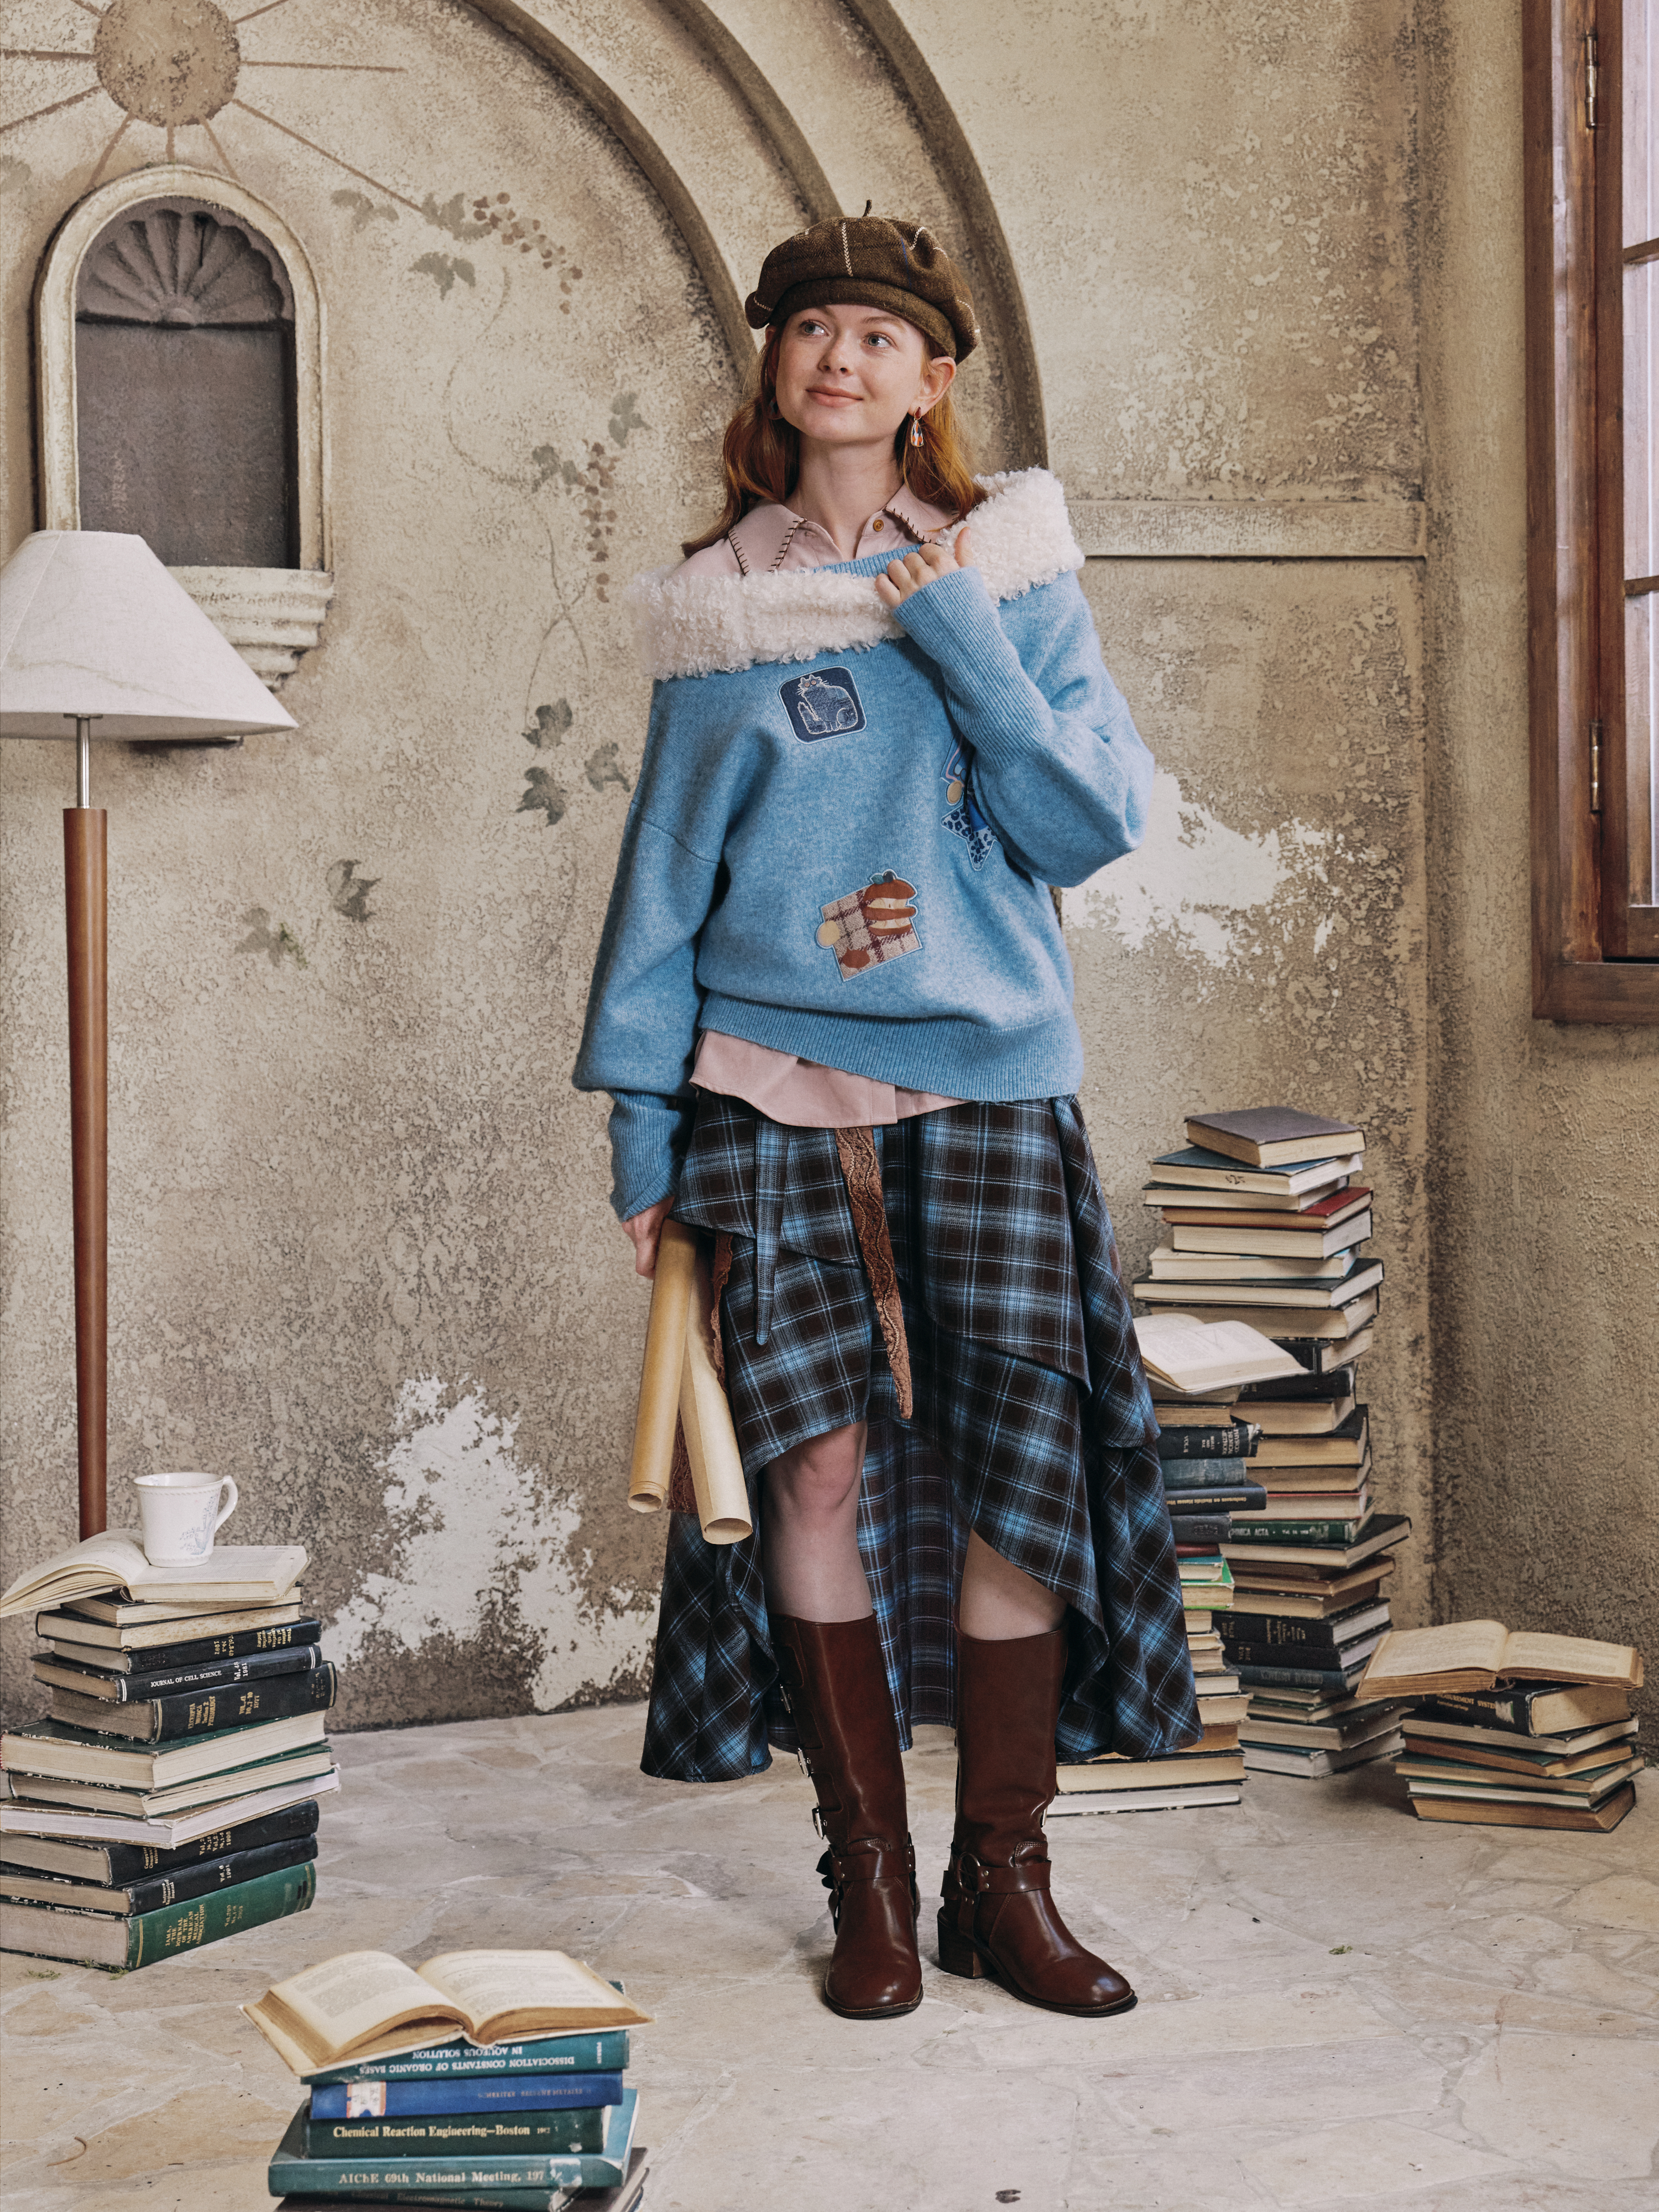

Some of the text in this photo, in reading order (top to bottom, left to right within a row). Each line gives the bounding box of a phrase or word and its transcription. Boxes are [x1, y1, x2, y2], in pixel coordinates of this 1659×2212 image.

[411, 2044, 523, 2059] IN AQUEOUS SOLUTION
[359, 2056, 575, 2074] DISSOCIATION CONSTANTS OF ORGANIC BASES
[333, 2126, 379, 2138] Chemical
[383, 2126, 425, 2138] Reaction
[339, 2170, 544, 2185] AIChE 69th National Meeting, 197
[472, 2195, 504, 2209] Theory
